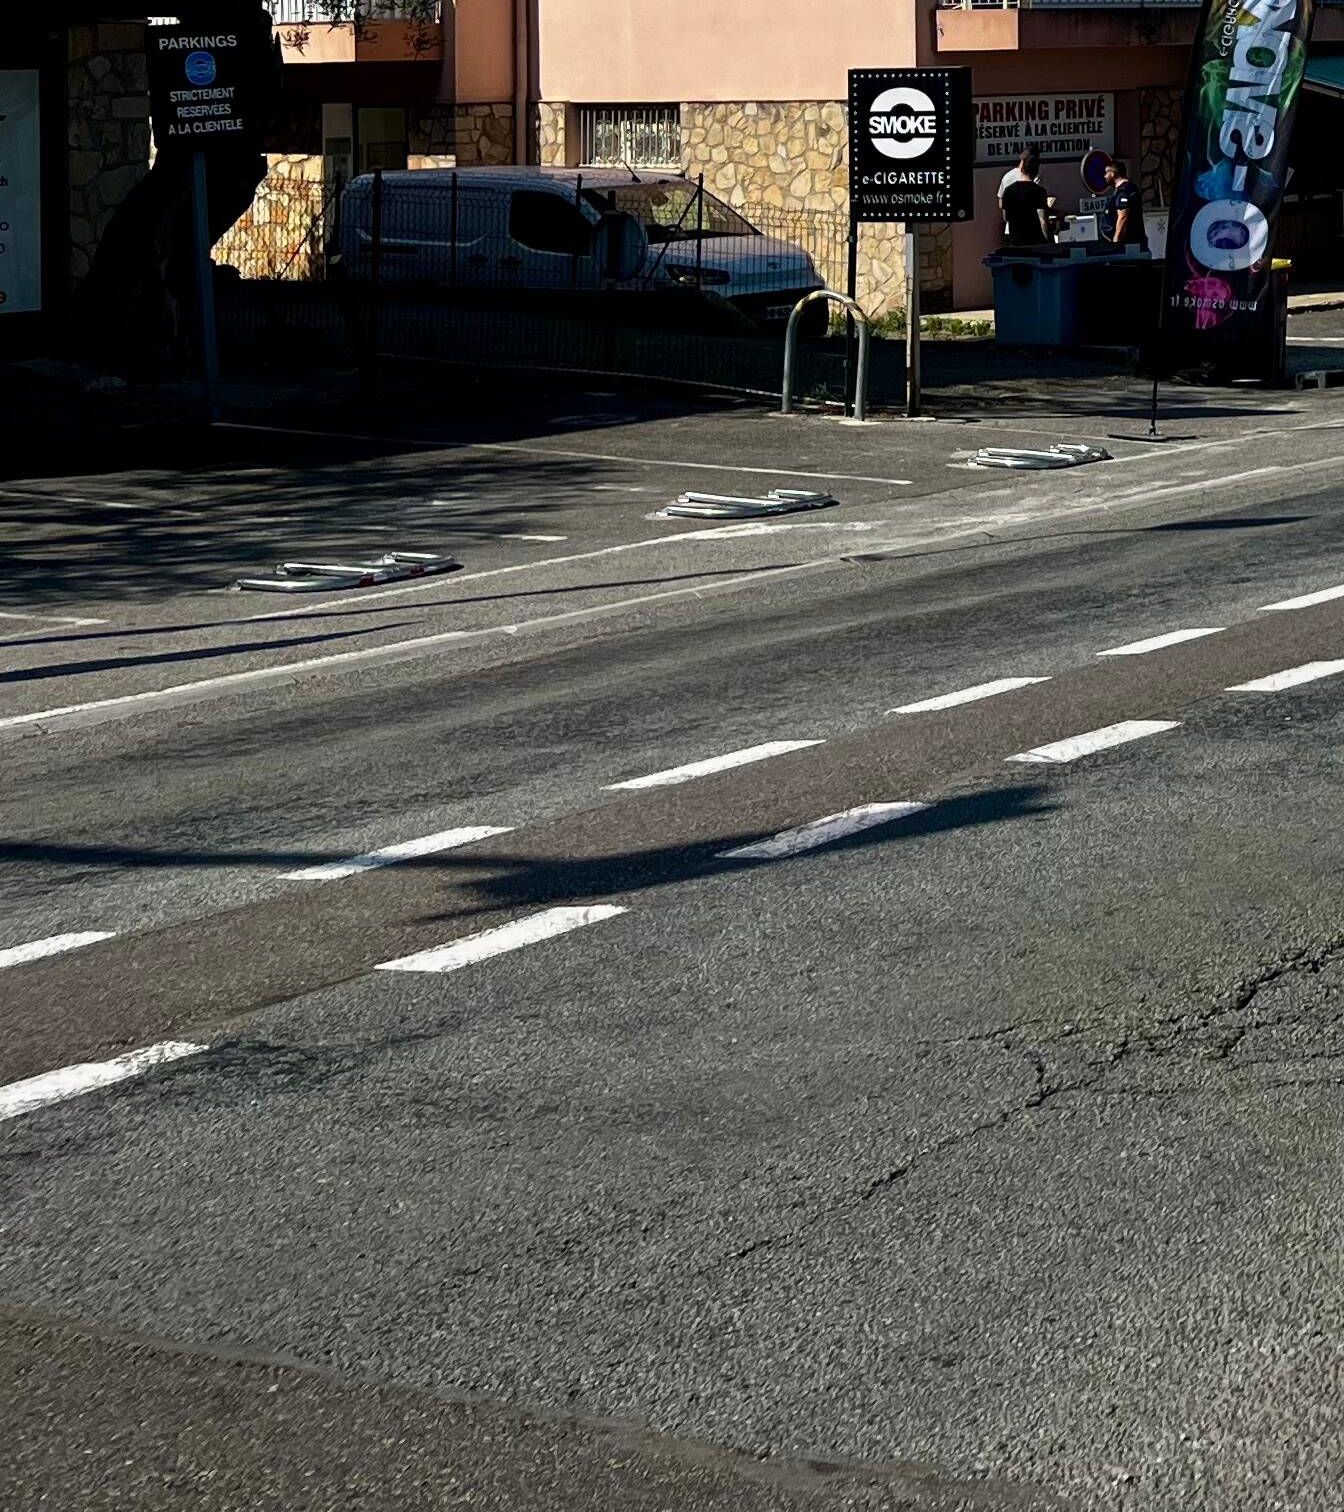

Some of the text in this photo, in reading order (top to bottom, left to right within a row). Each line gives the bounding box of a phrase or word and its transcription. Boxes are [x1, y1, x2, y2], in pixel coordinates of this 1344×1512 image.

[158, 35, 238, 50] PARKINGS
[169, 87, 235, 103] STRICTEMENT
[1054, 95, 1105, 120] PRIVÉ
[178, 123, 191, 135] LA
[193, 119, 244, 134] CLIENTELE
[869, 115, 937, 135] SMOKE
[1025, 122, 1033, 137] À
[1035, 123, 1048, 136] LA
[1050, 119, 1104, 135] CLIENTÈLE
[988, 143, 1002, 157] DE
[862, 171, 945, 185] e-CIGARETTE
